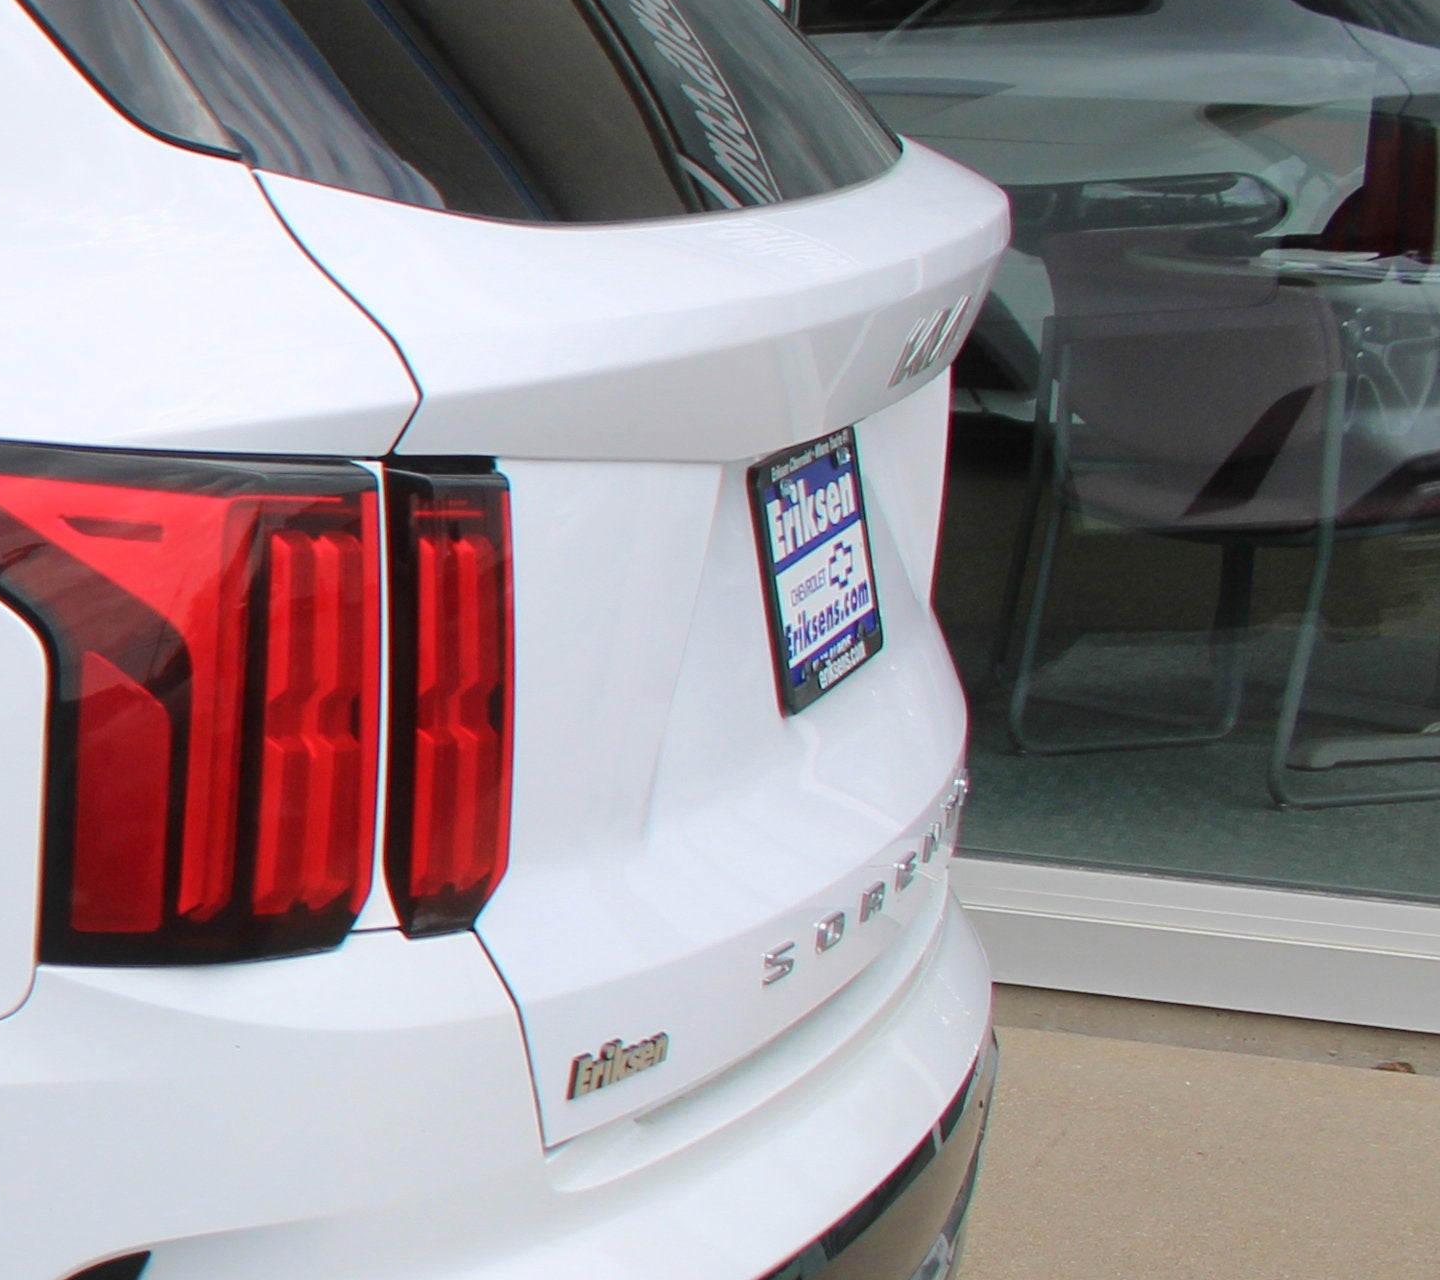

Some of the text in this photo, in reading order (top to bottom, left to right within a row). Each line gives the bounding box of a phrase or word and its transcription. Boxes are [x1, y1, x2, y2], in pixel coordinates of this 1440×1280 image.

[766, 472, 856, 563] Eriksen
[784, 580, 870, 661] Eriksens.com
[566, 1031, 669, 1101] Eriksen
